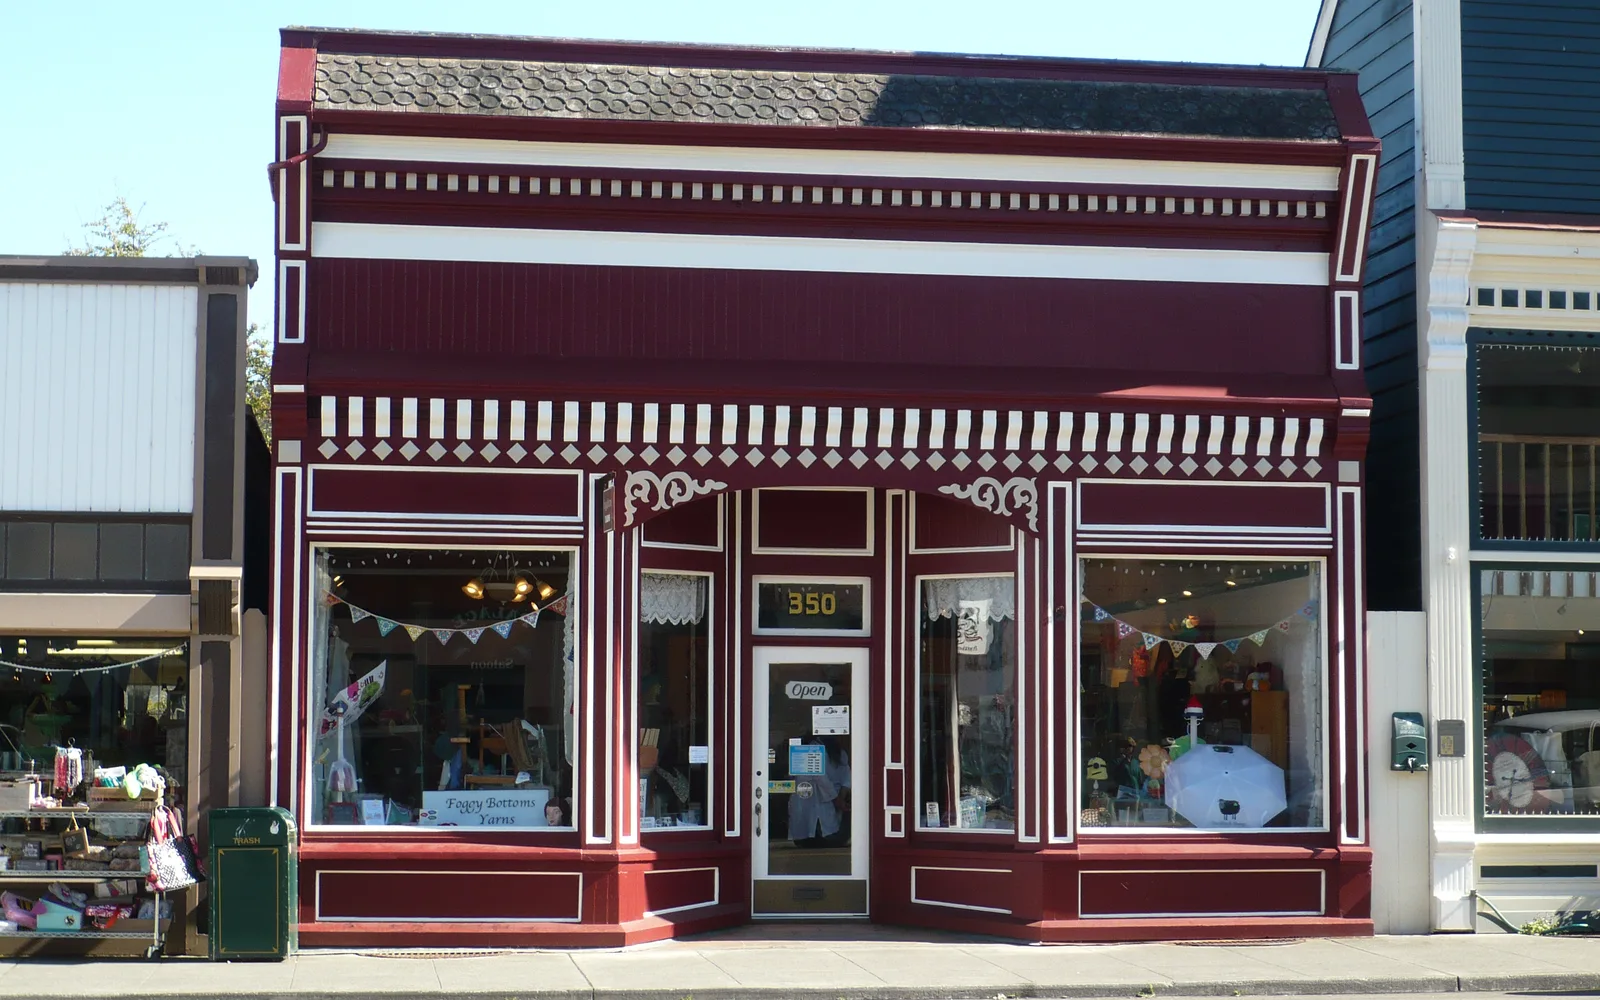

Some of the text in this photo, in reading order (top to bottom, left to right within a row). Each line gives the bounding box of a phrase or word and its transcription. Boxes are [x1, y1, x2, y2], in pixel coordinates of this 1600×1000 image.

[788, 592, 836, 615] 350
[792, 683, 827, 699] Open
[446, 797, 536, 814] Foggy Bottoms
[480, 814, 516, 825] Yarns
[232, 837, 260, 845] TRASH
